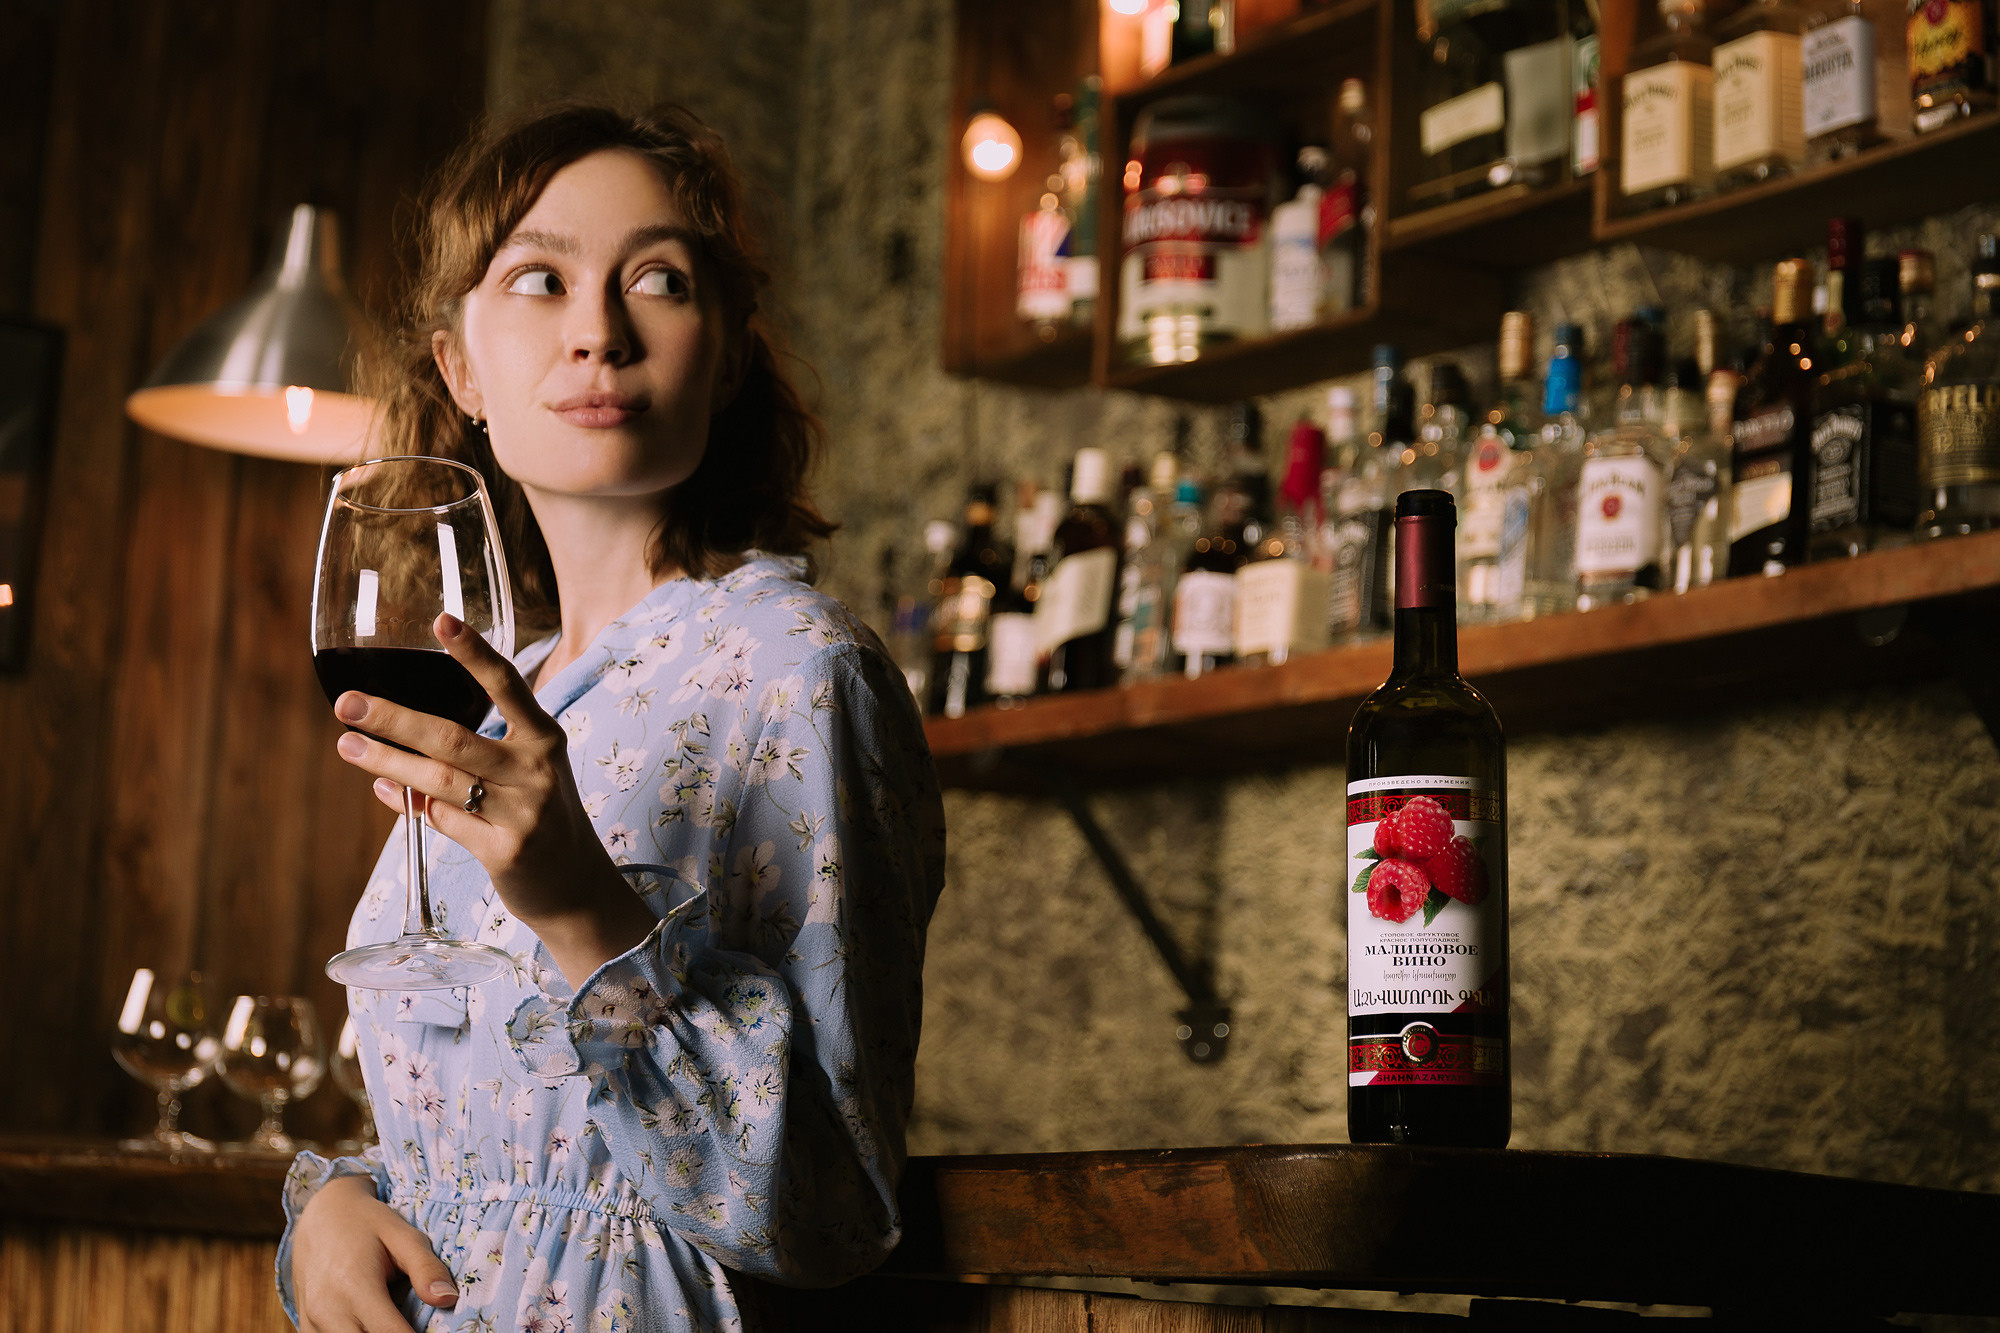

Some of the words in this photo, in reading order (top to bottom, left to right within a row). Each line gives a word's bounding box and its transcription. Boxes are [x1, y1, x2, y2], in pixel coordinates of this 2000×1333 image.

[1368, 779, 1421, 787] ПРОИЗВЕДЕНО
[1365, 944, 1479, 956] МАЛИНОВОЕ
[1392, 956, 1446, 967] ВИНО
[1376, 1073, 1465, 1082] SHAHNAZARYAN
